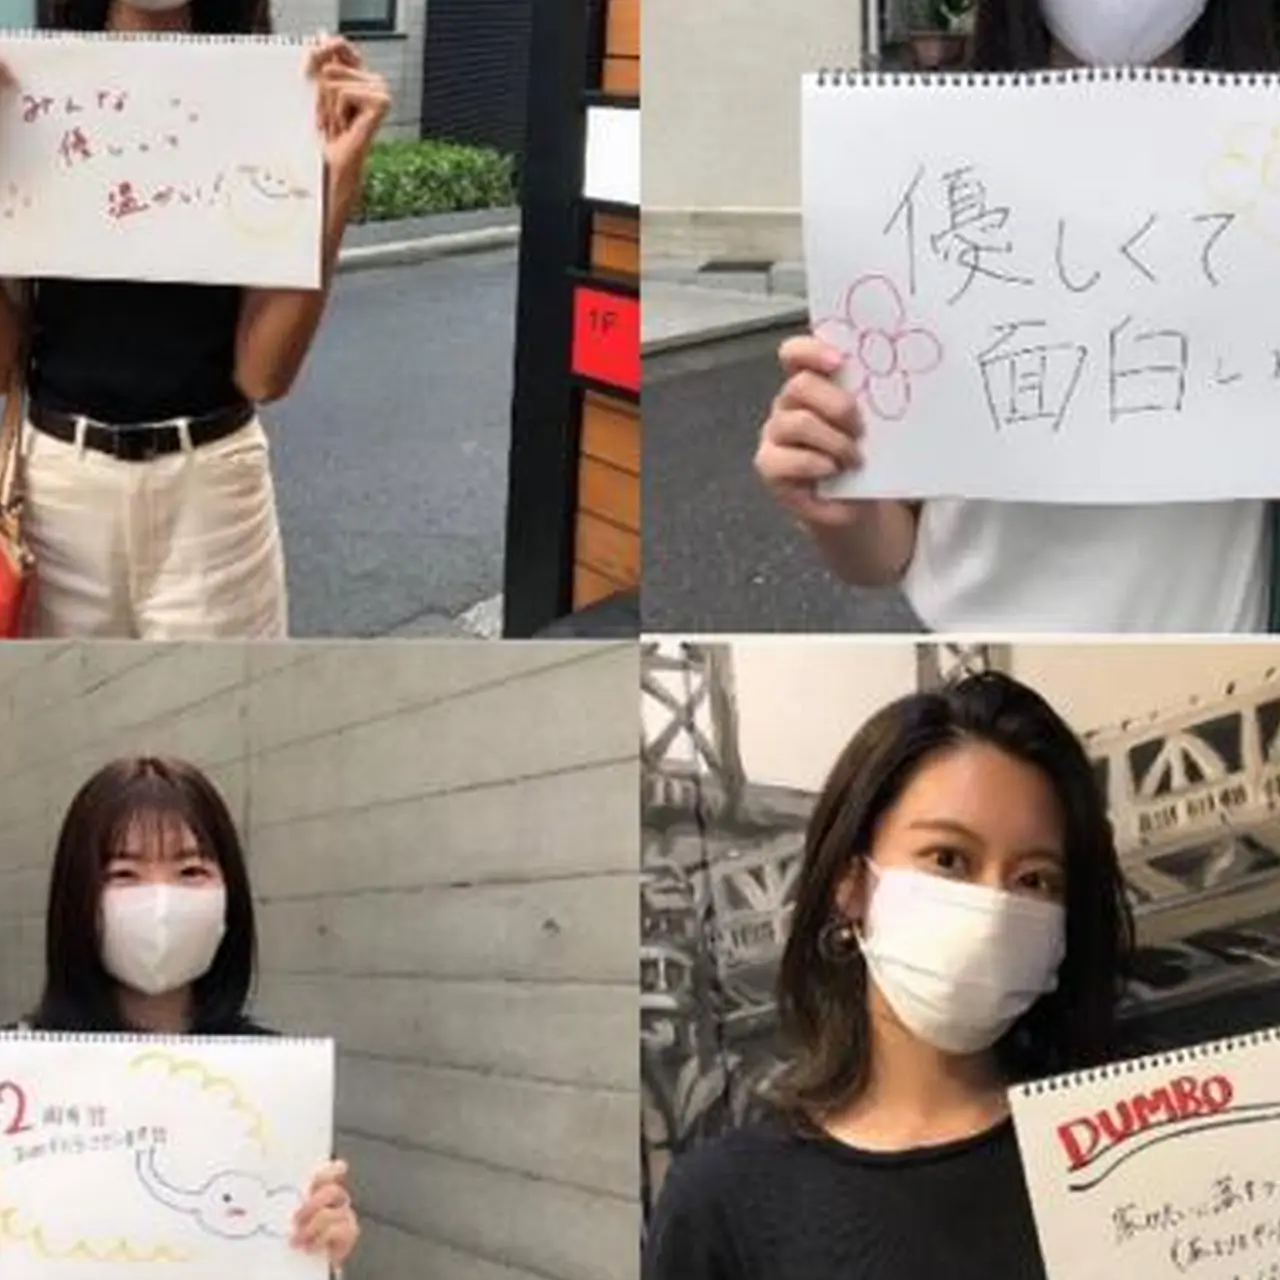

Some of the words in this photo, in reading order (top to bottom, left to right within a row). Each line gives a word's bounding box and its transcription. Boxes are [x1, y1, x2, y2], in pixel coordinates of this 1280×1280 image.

[883, 163, 1238, 306] 優しくて
[588, 310, 616, 335] 1F
[1056, 1072, 1237, 1172] DUMBO
